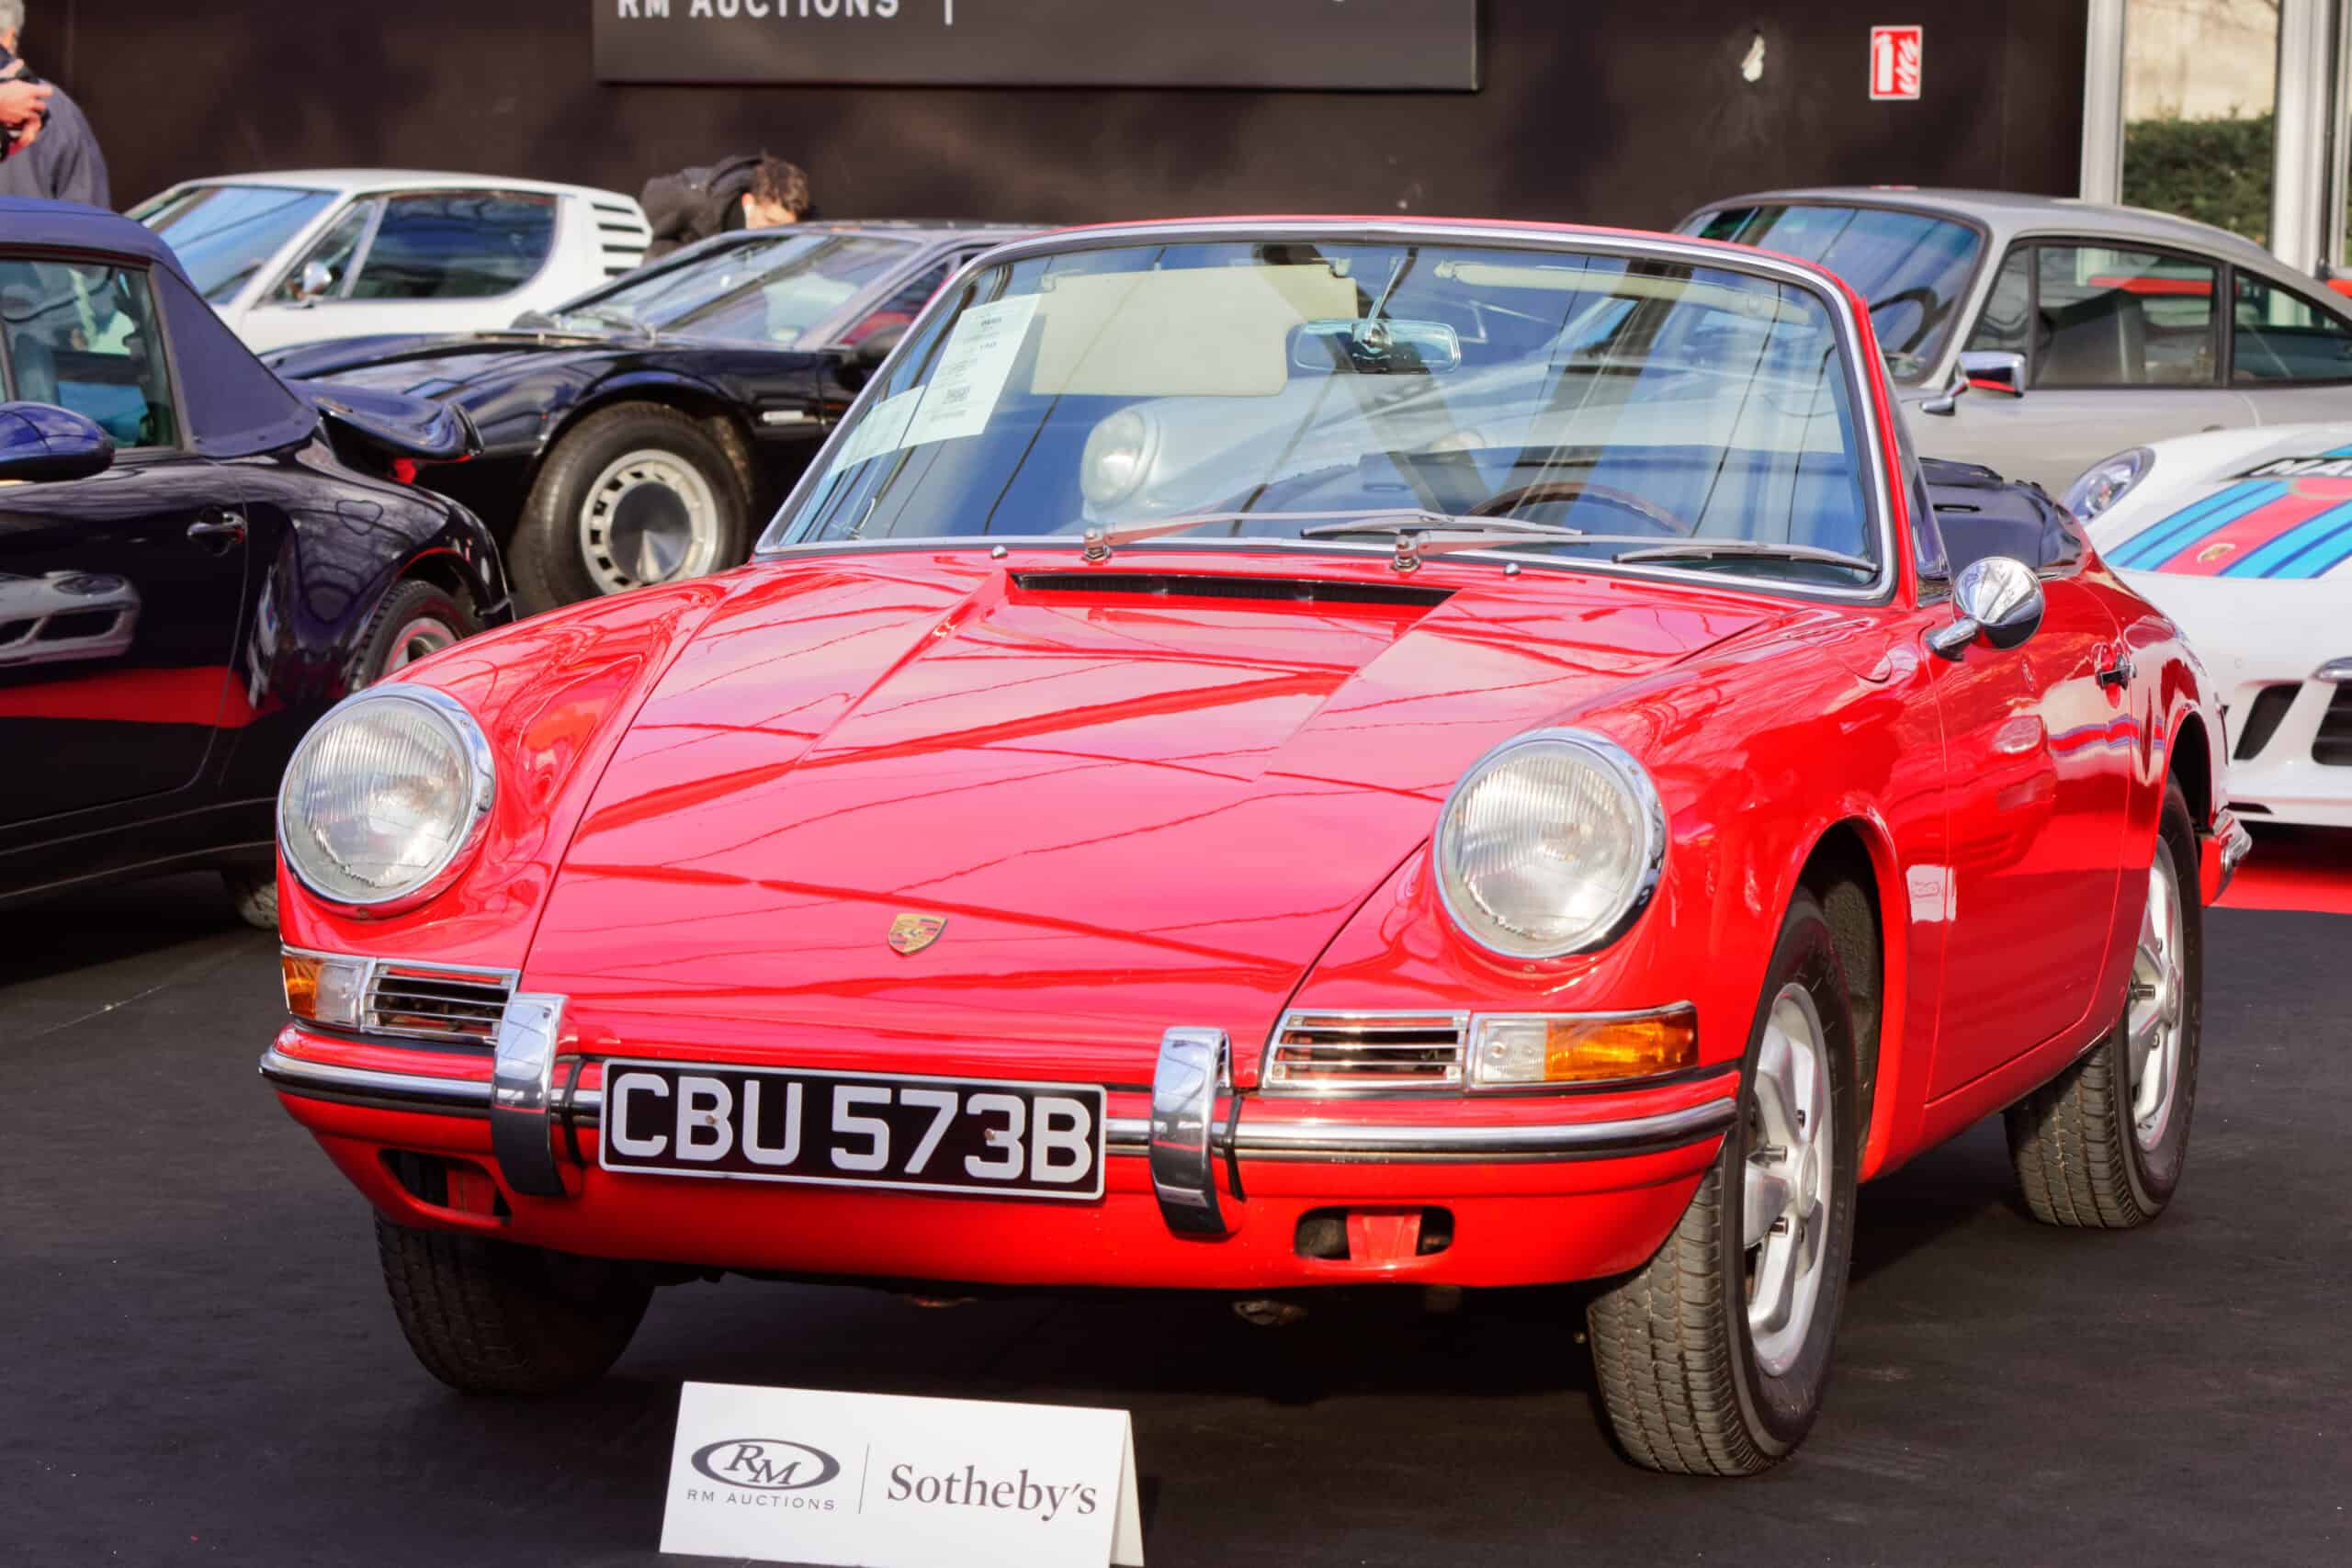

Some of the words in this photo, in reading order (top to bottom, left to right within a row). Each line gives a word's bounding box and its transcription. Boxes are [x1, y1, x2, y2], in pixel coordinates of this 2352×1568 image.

[611, 1072, 803, 1166] CBU
[831, 1084, 1092, 1183] 573B
[723, 1444, 801, 1485] RM
[686, 1489, 715, 1502] RM
[726, 1493, 835, 1511] AUCTIONS
[888, 1463, 1097, 1521] Sotheby's
